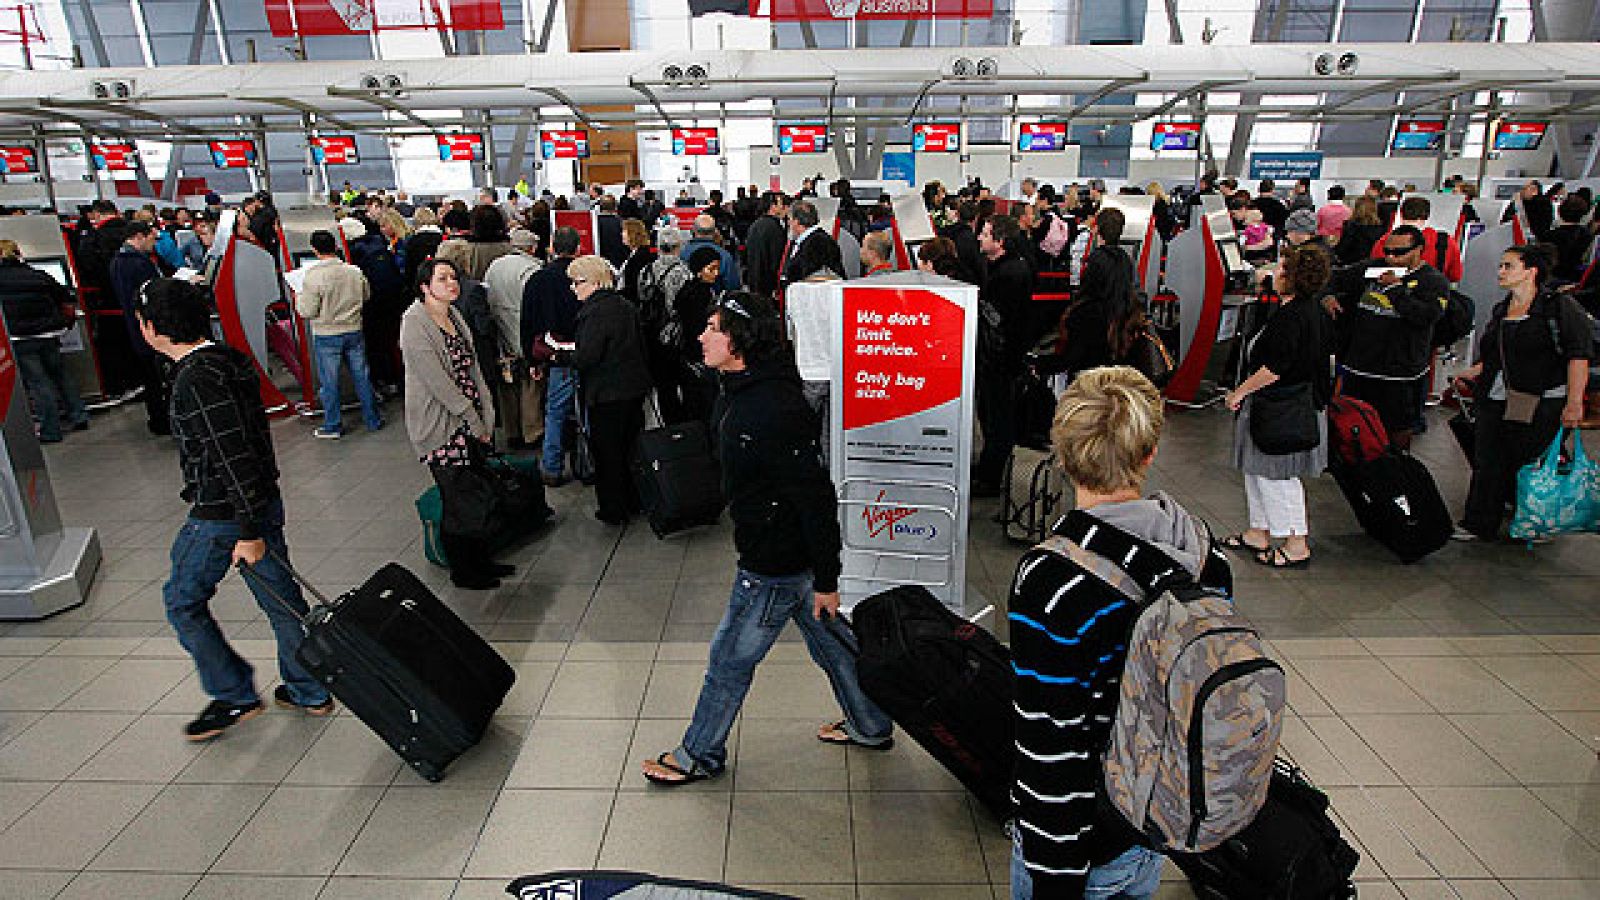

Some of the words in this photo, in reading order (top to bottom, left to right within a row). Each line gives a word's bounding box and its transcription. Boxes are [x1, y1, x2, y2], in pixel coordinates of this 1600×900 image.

[857, 310, 883, 325] We
[887, 311, 931, 325] don't
[855, 327, 893, 340] limit
[855, 342, 918, 356] service.
[855, 370, 891, 388] Only
[895, 372, 925, 390] bag
[855, 386, 890, 400] size.
